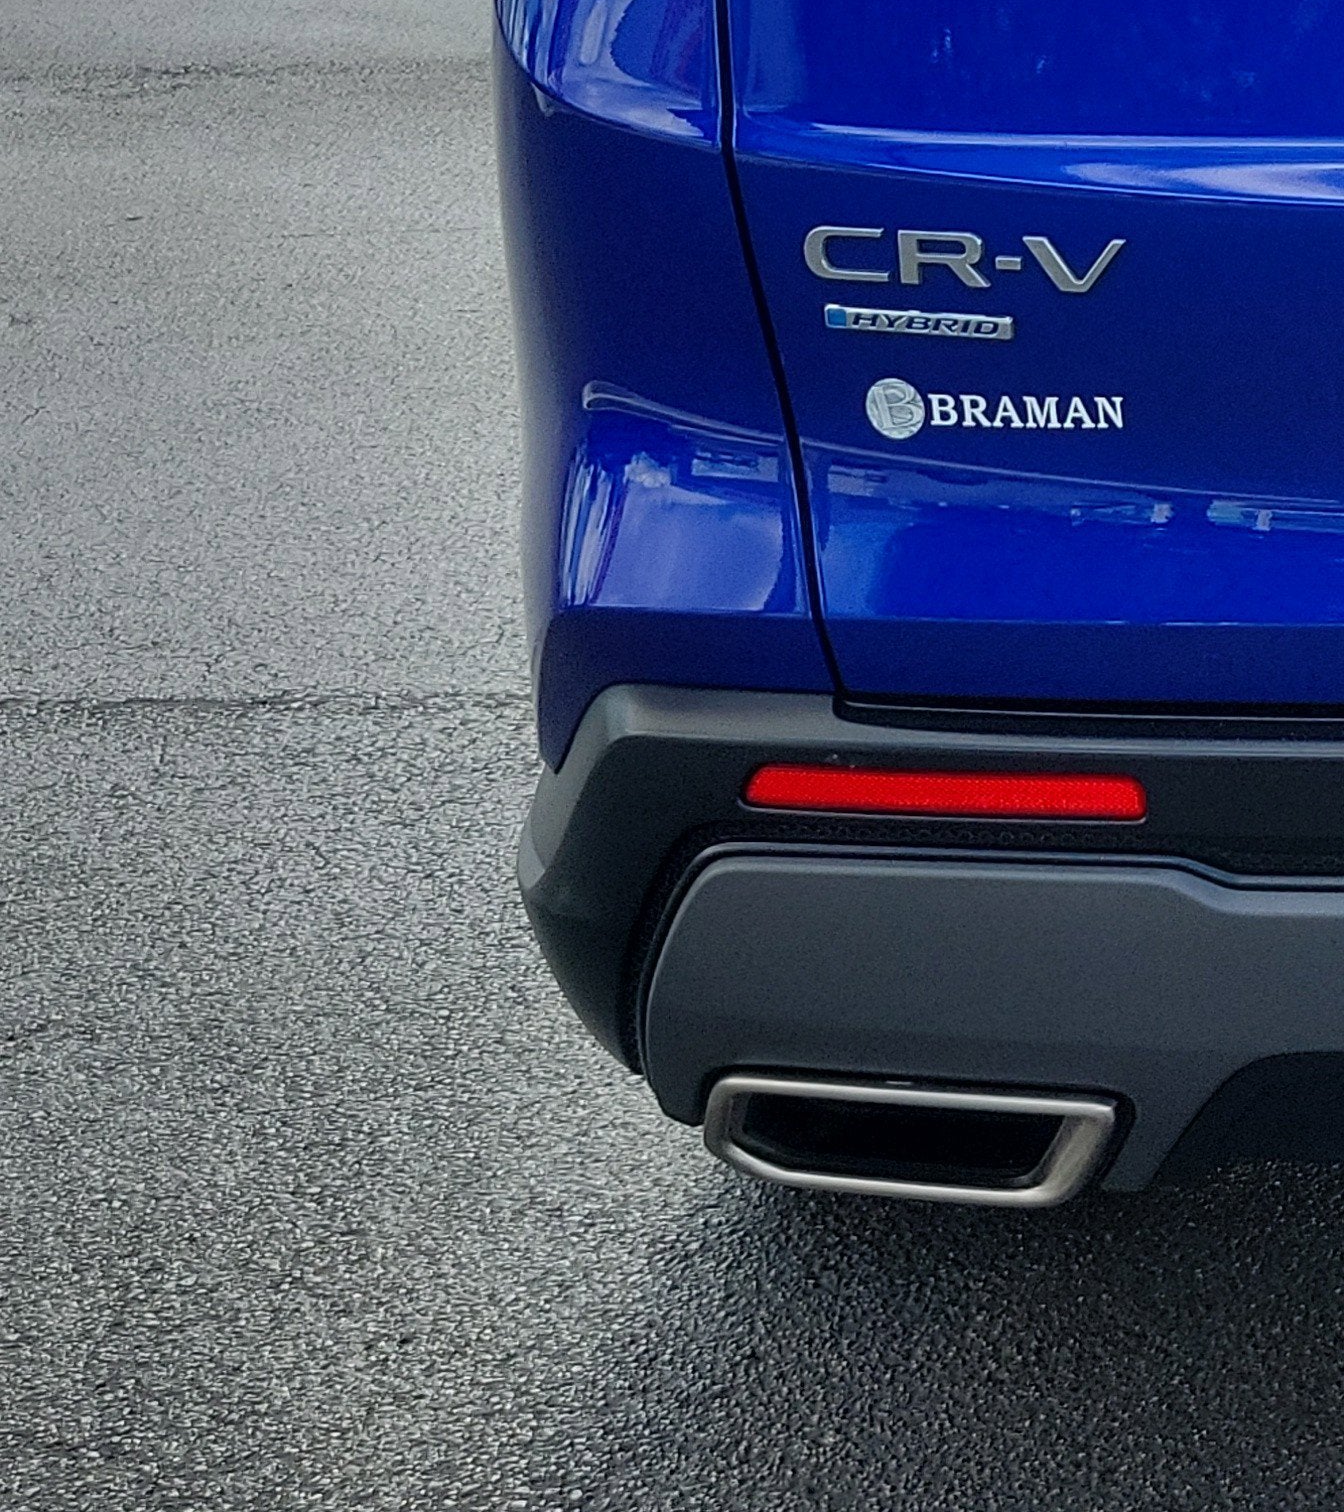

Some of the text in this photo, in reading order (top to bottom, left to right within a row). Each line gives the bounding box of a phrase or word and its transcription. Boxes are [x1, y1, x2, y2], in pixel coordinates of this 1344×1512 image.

[803, 225, 1127, 293] CR-V
[851, 312, 1000, 336] HYBRID
[927, 393, 1124, 429] BRAMAN
